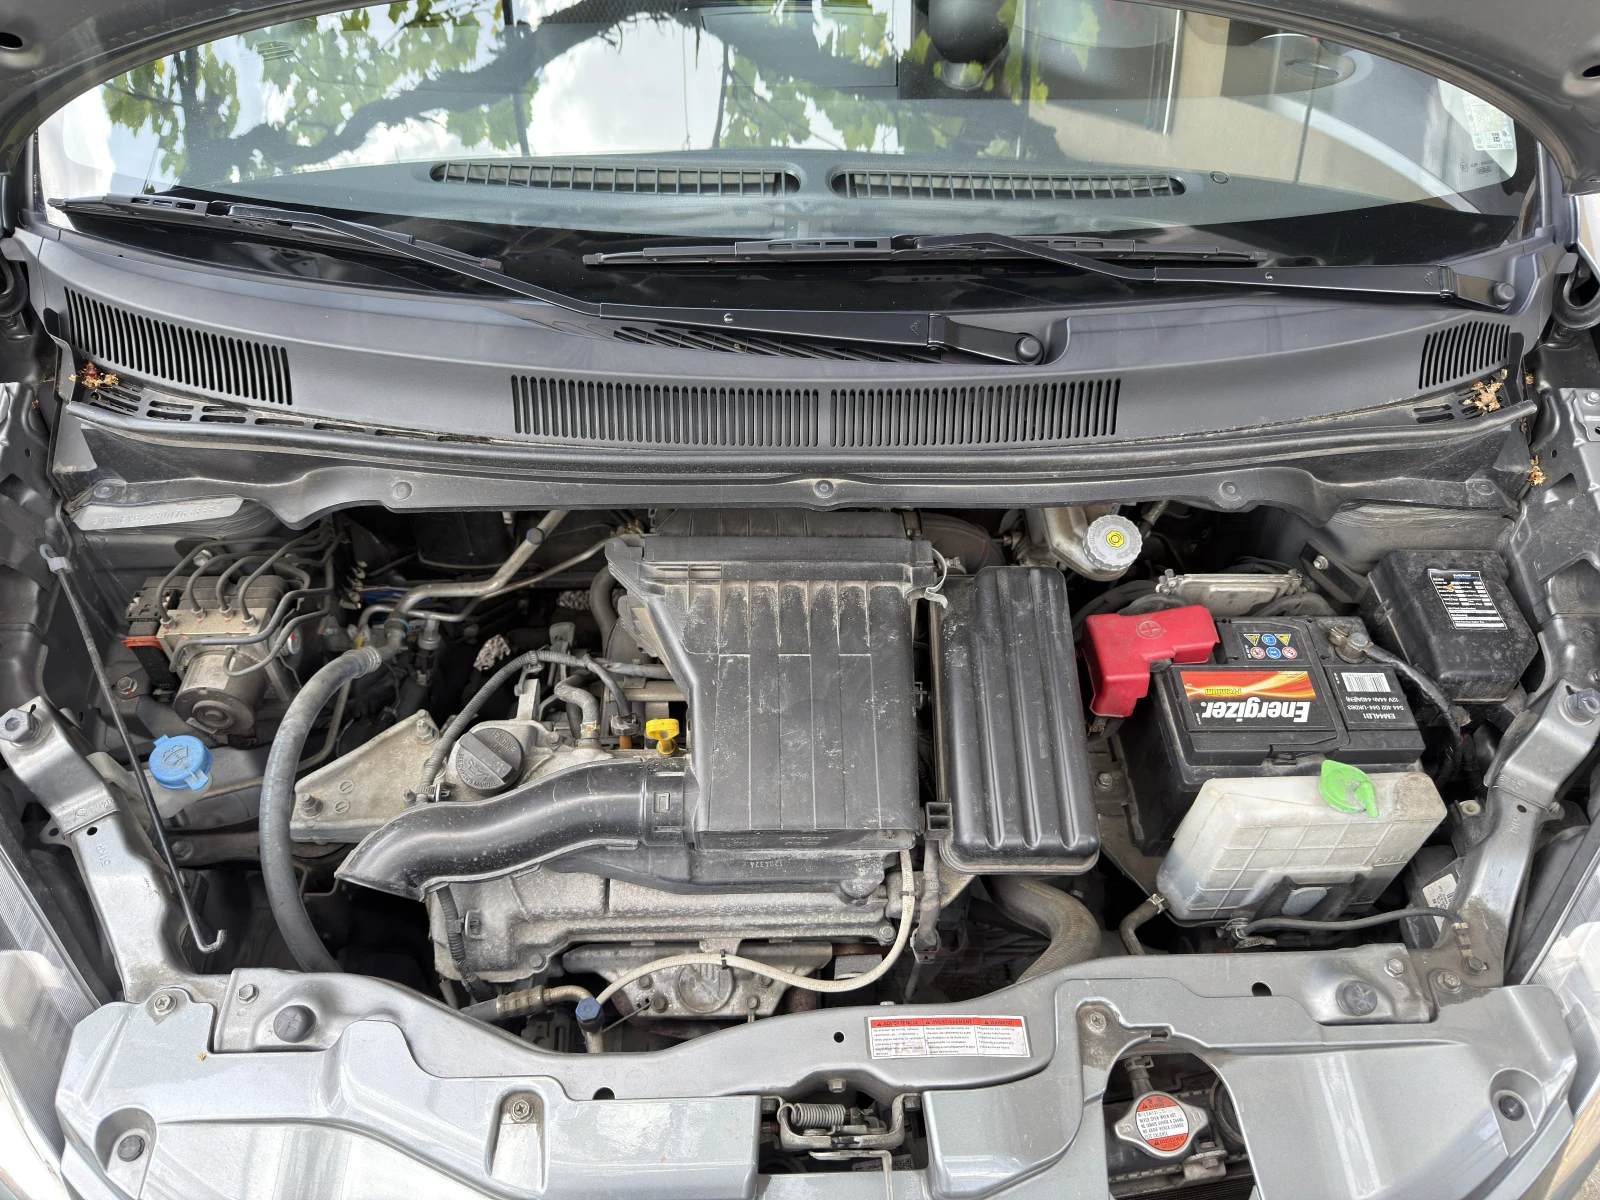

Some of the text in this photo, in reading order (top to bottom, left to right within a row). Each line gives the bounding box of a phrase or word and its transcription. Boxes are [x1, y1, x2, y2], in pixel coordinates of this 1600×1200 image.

[1205, 689, 1242, 697] Premium
[491, 730, 518, 753] ENGINE
[491, 742, 502, 756] OIL
